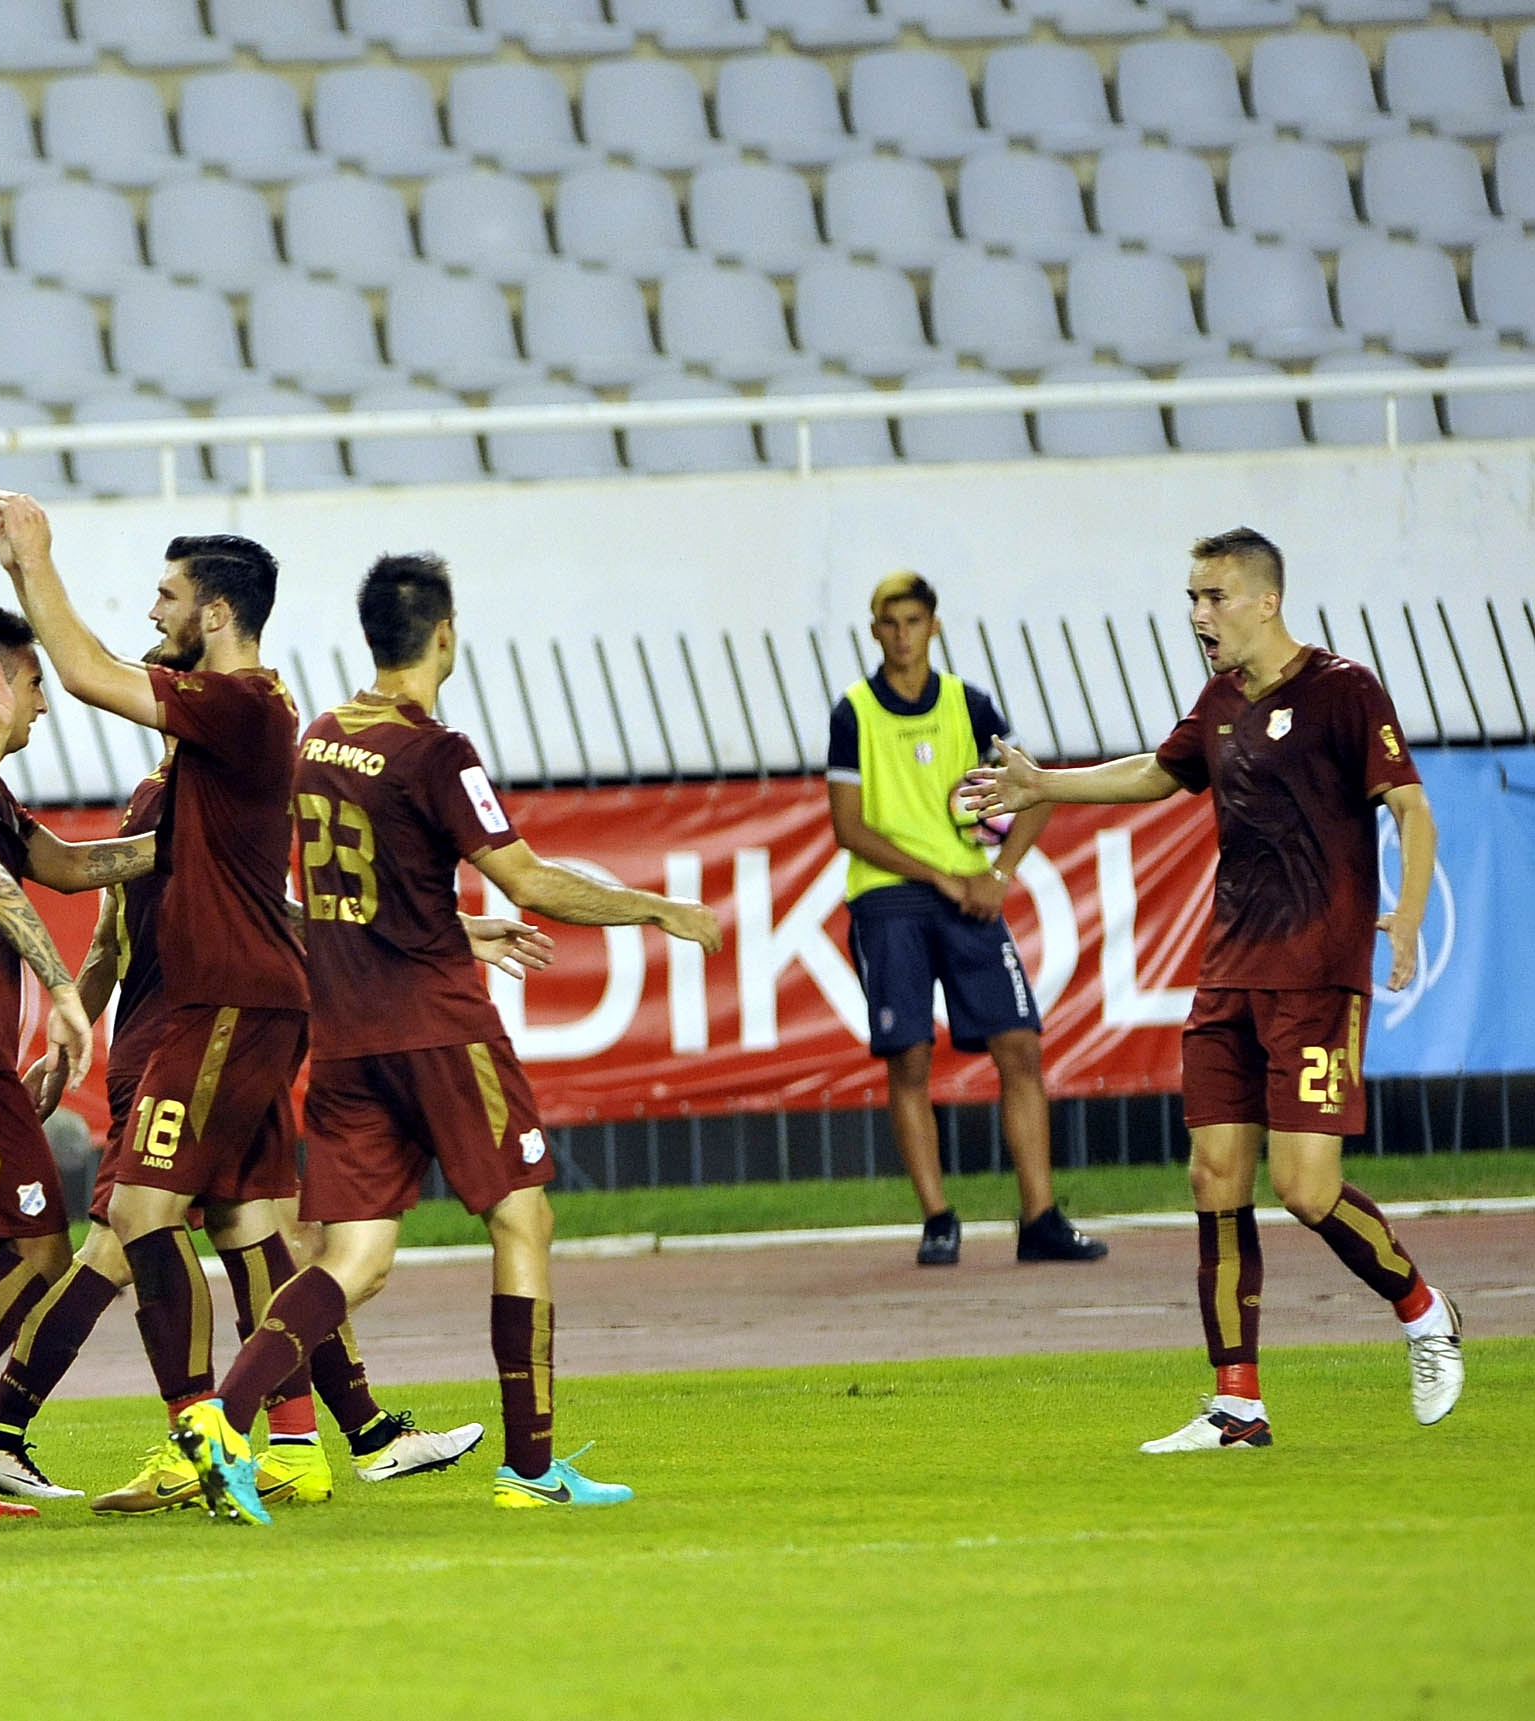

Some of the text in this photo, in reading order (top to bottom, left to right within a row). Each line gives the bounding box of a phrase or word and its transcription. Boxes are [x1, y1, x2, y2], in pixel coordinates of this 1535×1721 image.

[300, 738, 386, 777] FRANKO
[297, 793, 378, 924] 23
[133, 1095, 186, 1158] 18
[141, 1155, 174, 1170] JAKO
